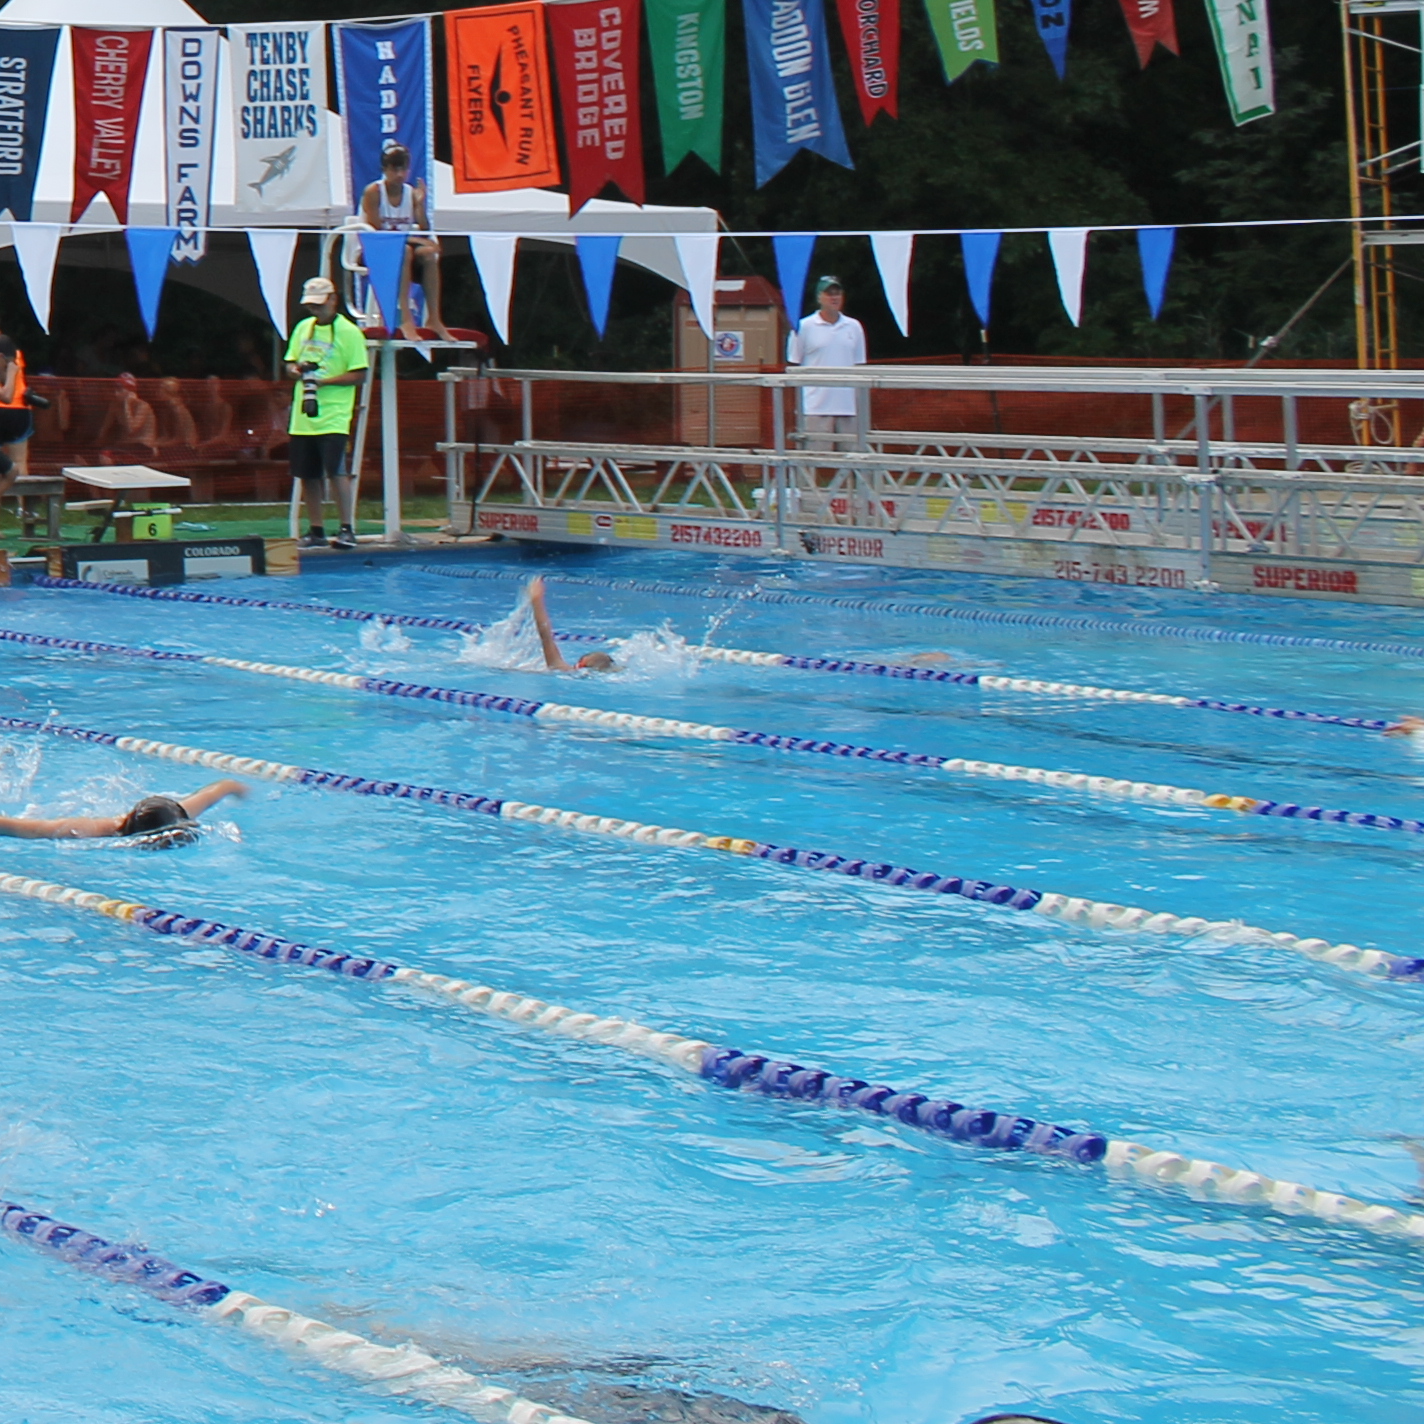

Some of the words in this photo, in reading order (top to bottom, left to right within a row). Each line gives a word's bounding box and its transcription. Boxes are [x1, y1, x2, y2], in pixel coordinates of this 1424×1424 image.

[94, 35, 129, 109] CHERRY
[246, 31, 309, 66] TENBY
[507, 25, 534, 120] PHEASANT
[674, 12, 704, 121] KINGSTON
[178, 37, 202, 149] DOWNS
[247, 67, 310, 103] CHASE
[467, 64, 484, 136] FLYERS
[573, 28, 600, 149] BRIDGE
[599, 7, 628, 160] COVERED
[782, 81, 824, 144] GLEN
[88, 117, 125, 182] VALLEY
[241, 104, 317, 139] SHARKS
[516, 127, 534, 166] RUN
[176, 163, 199, 251] FARM
[147, 522, 158, 537] 6
[184, 546, 241, 558] COLORADO
[478, 511, 538, 533] SUPERIOR
[670, 524, 762, 548] 2157432200
[1253, 564, 1359, 594] SUPERIOR
